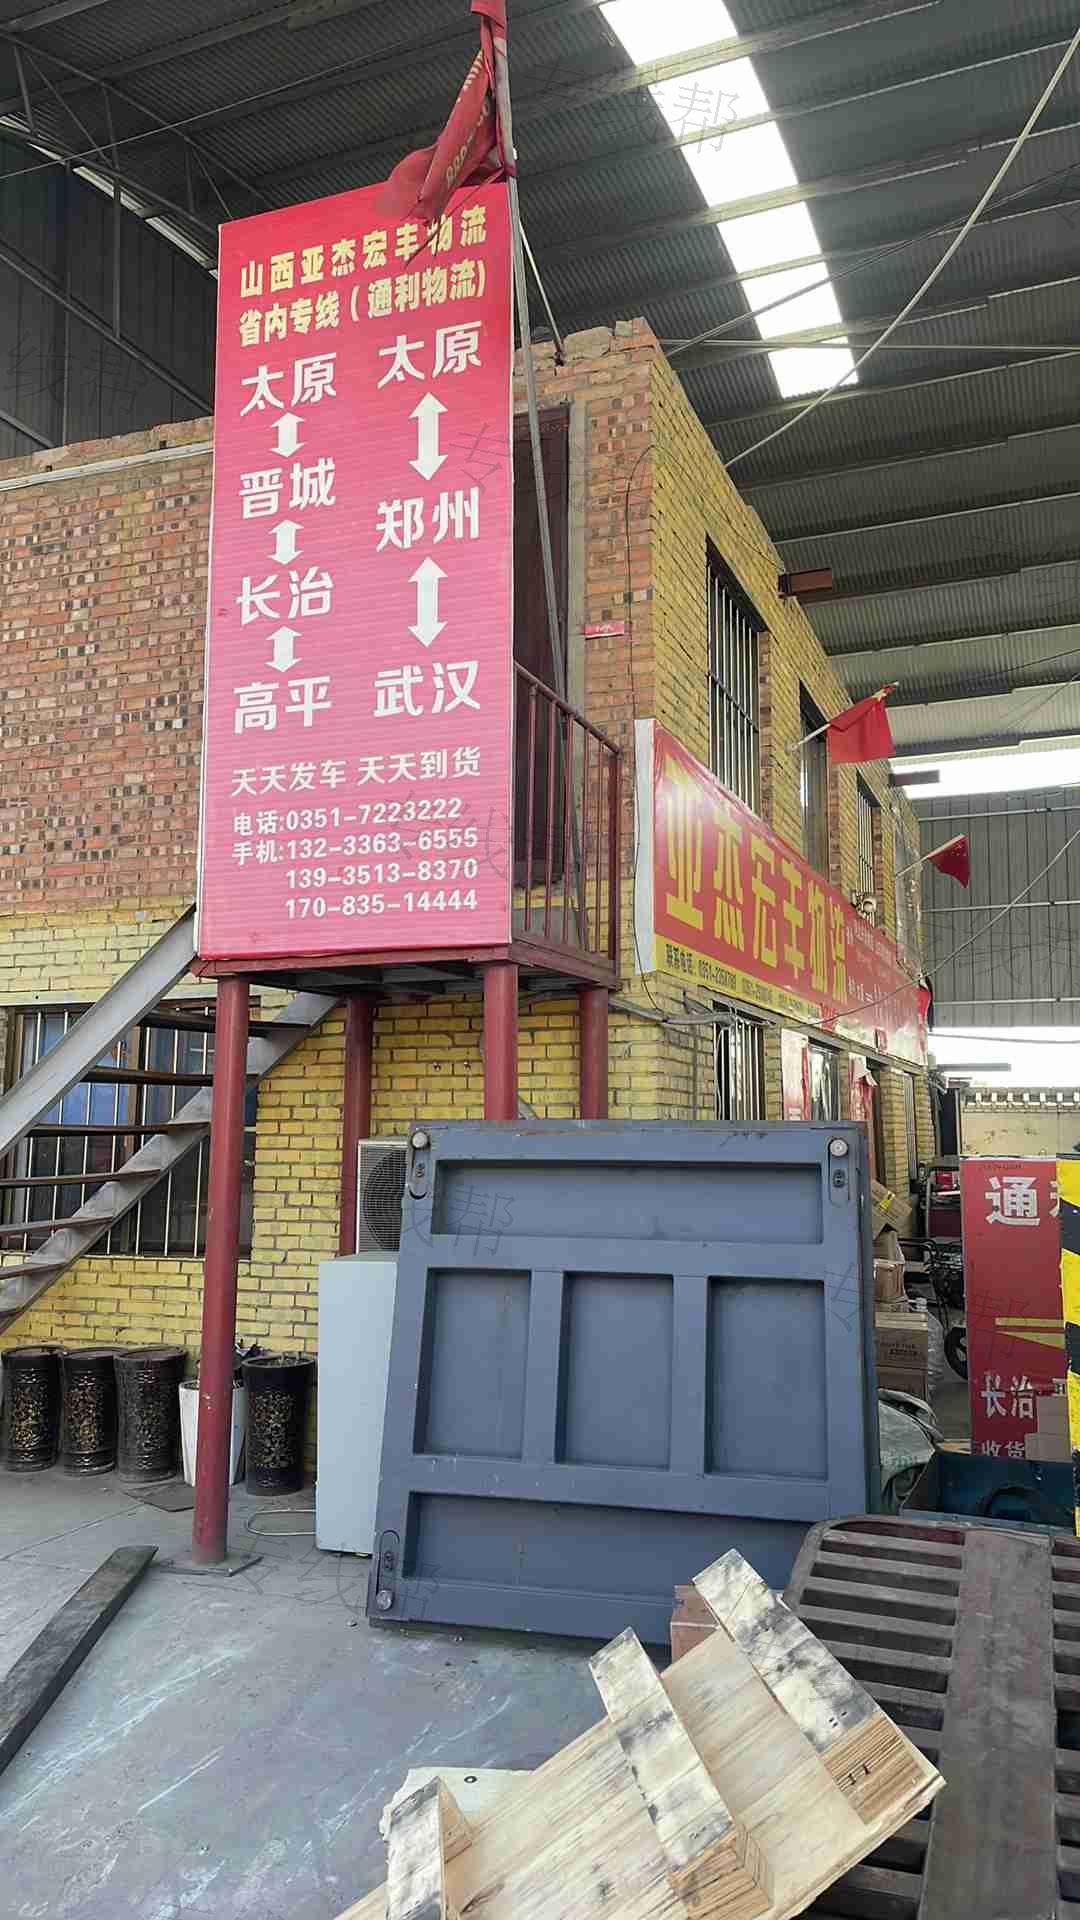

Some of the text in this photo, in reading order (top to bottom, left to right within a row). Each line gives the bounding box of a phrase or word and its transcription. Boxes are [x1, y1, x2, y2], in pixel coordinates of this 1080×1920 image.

[239, 205, 487, 298] 山西亚杰宏丰物流
[240, 321, 482, 417] 太原 太原
[239, 457, 480, 552] 晋城 郑州
[236, 566, 334, 626] 长治
[233, 661, 481, 734] 高平 武汉
[231, 747, 481, 797] 天天发车 天天到货
[286, 859, 478, 889] 139-3513-8370
[286, 889, 478, 919] 170-835-14444
[981, 1371, 1034, 1418] 长治
